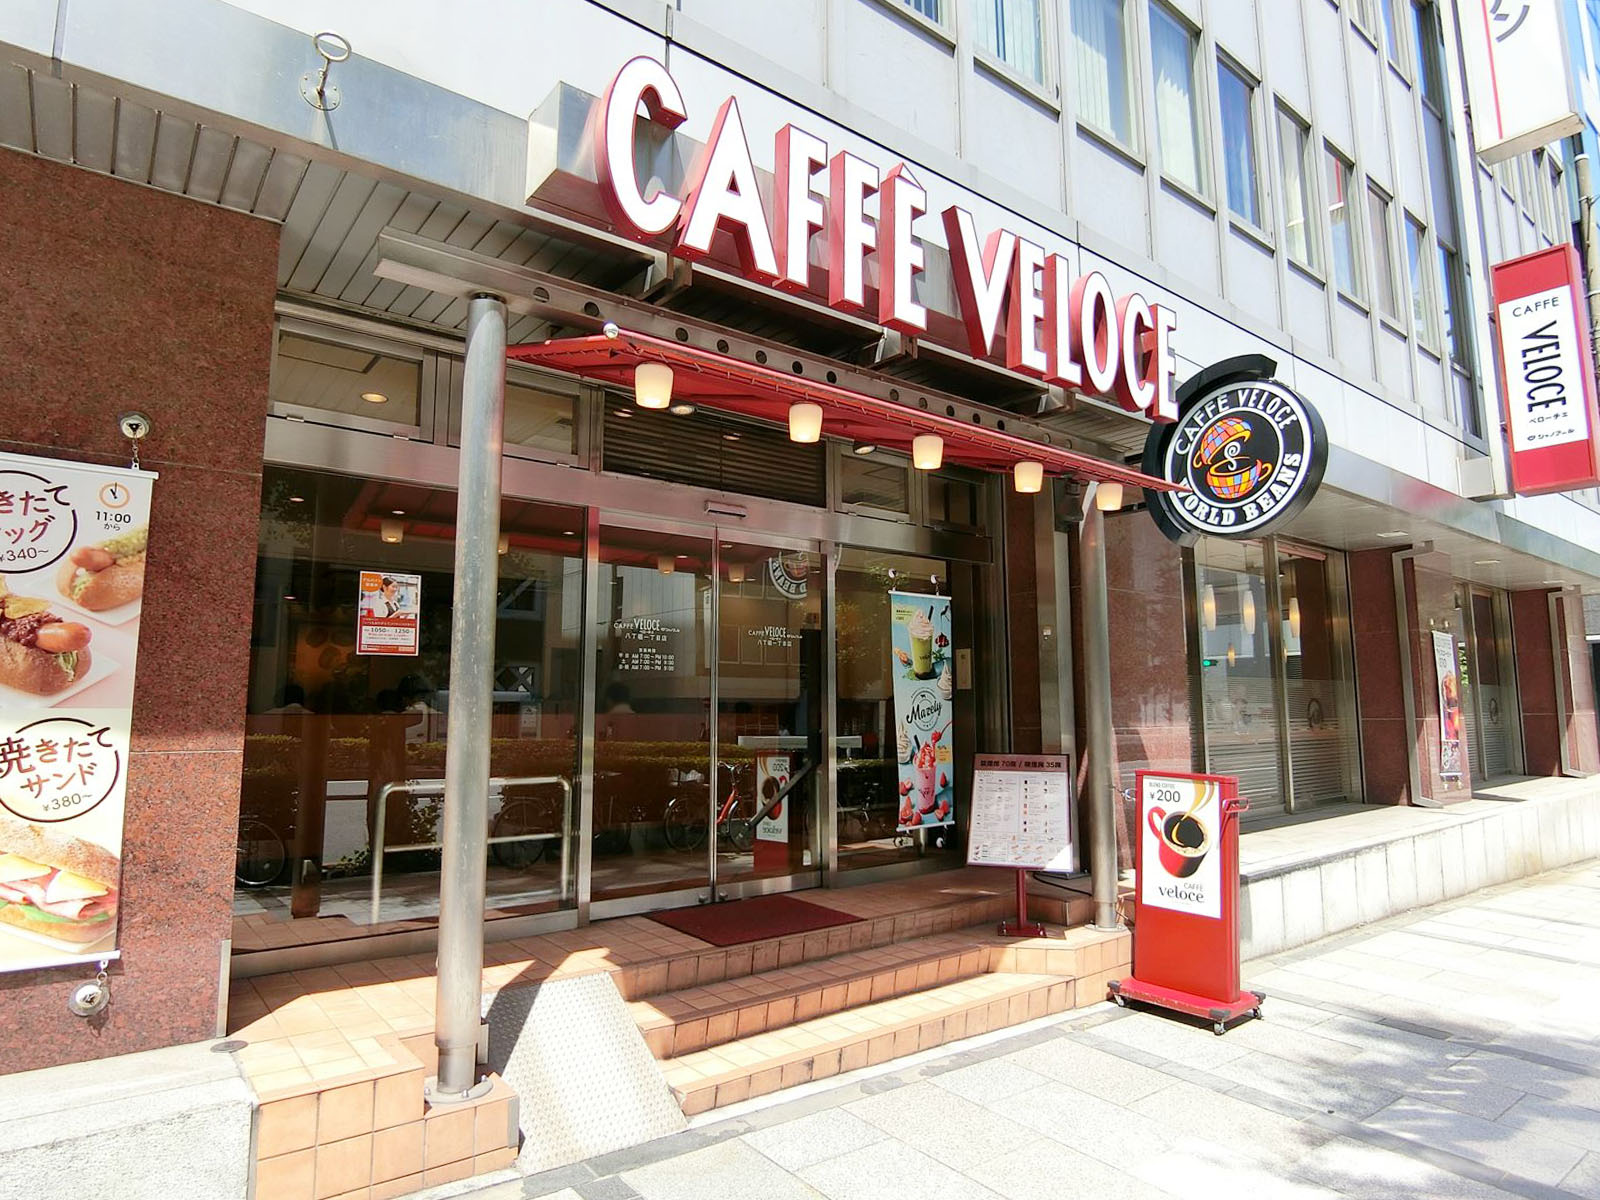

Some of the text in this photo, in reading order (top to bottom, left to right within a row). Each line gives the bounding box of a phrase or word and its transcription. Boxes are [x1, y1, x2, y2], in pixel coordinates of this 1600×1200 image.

[942, 205, 1179, 423] VELOCE
[1512, 297, 1560, 318] CAFFE
[1521, 320, 1567, 412] VELOCE
[1175, 389, 1298, 455] CAFFE VELOCE
[1243, 453, 1302, 522] BEANS
[96, 511, 131, 524] 11:00
[103, 523, 121, 531] から
[0, 515, 56, 545] ッグ
[633, 618, 660, 632] VELOCE
[764, 626, 786, 638] VELOCE
[20, 762, 98, 799] サンド
[1150, 789, 1181, 802] ¥200
[1158, 885, 1205, 903] veloce
